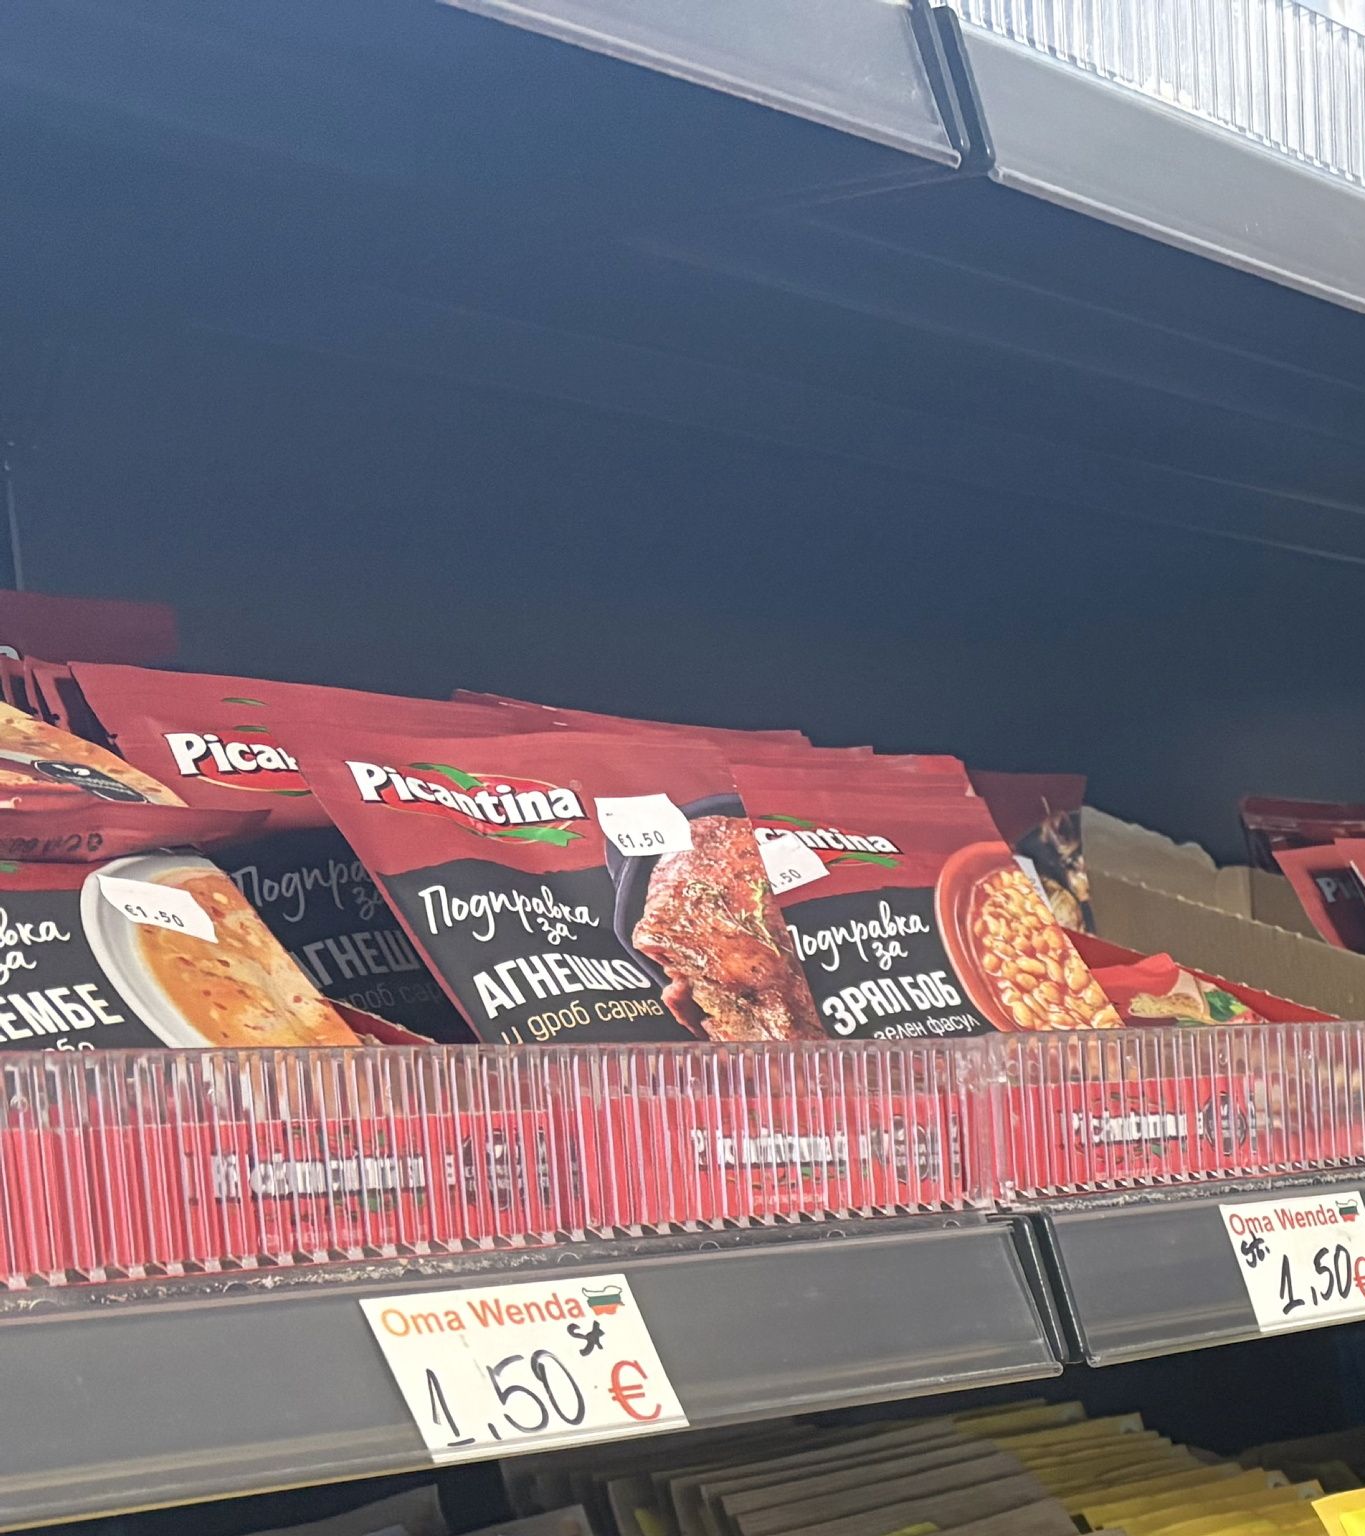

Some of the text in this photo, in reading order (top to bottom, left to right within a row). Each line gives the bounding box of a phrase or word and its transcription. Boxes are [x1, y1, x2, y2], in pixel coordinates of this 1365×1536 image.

[344, 758, 587, 828] Picantina
[617, 830, 665, 848] €1.50
[756, 825, 899, 858] cantina
[124, 903, 186, 929] €1.50
[418, 884, 600, 942] Подправка
[538, 917, 577, 946] за
[871, 940, 909, 970] за
[473, 951, 654, 1020] АГНЕШКО
[822, 970, 962, 1038] ЗРЯЛ БОБ
[527, 1006, 591, 1045] дроб
[595, 996, 664, 1028] сарма
[1229, 1204, 1339, 1236] Oma Wenda
[1279, 1244, 1352, 1315] 1,50
[381, 1293, 585, 1338] Oma Wenda
[426, 1349, 662, 1447] 1,50 €
